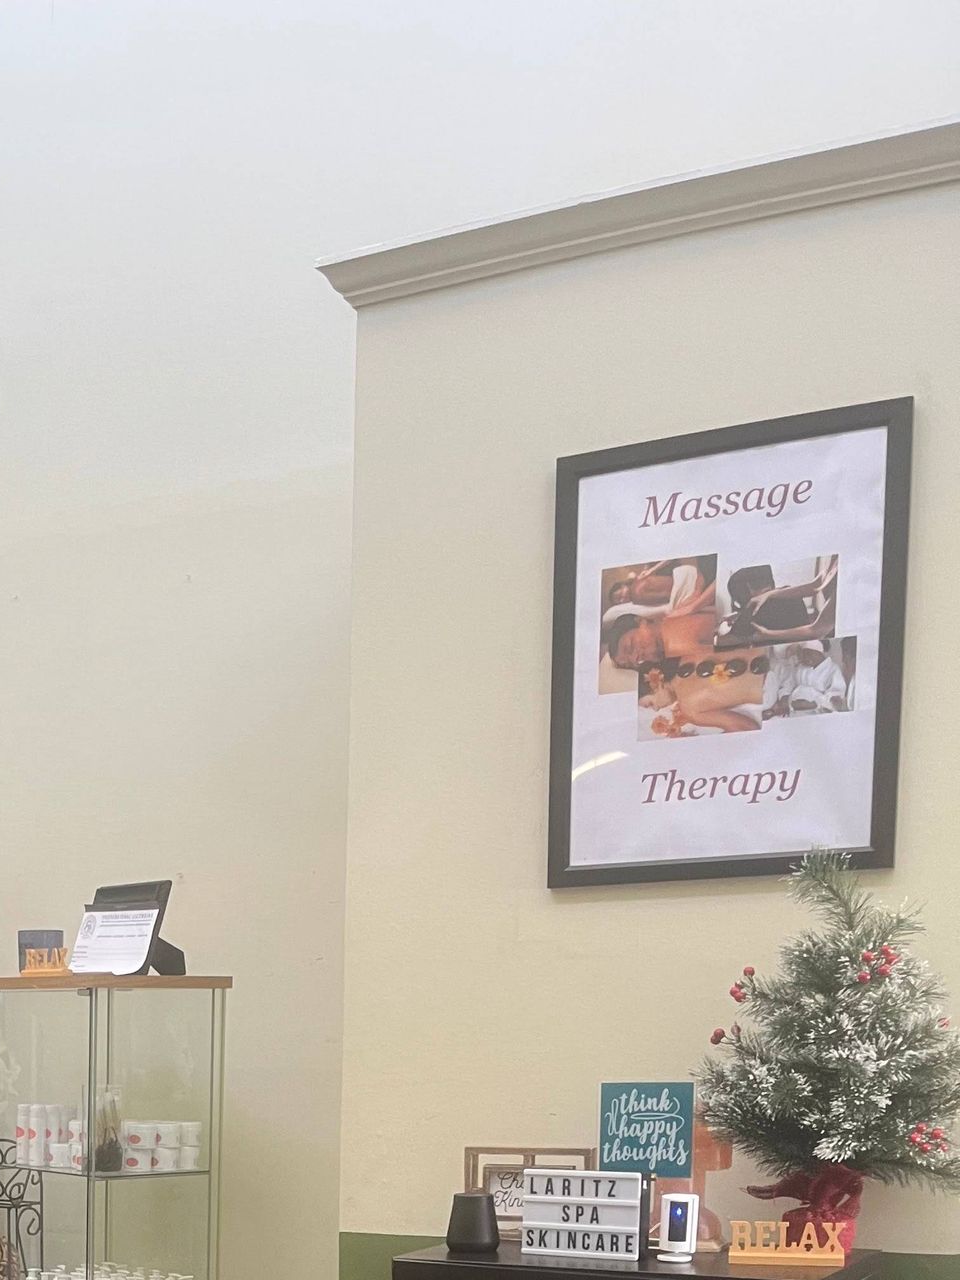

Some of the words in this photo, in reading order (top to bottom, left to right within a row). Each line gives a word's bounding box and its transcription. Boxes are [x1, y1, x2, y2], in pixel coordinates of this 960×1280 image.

[638, 479, 813, 528] Massage
[641, 768, 802, 804] Therapy
[619, 1088, 674, 1114] think
[613, 1114, 680, 1147] happy
[602, 1137, 689, 1170] thoughts
[529, 1177, 617, 1198] LARITZ
[561, 1205, 600, 1225] SPA
[525, 1229, 635, 1253] SKINCARE
[729, 1220, 847, 1254] RELAX
